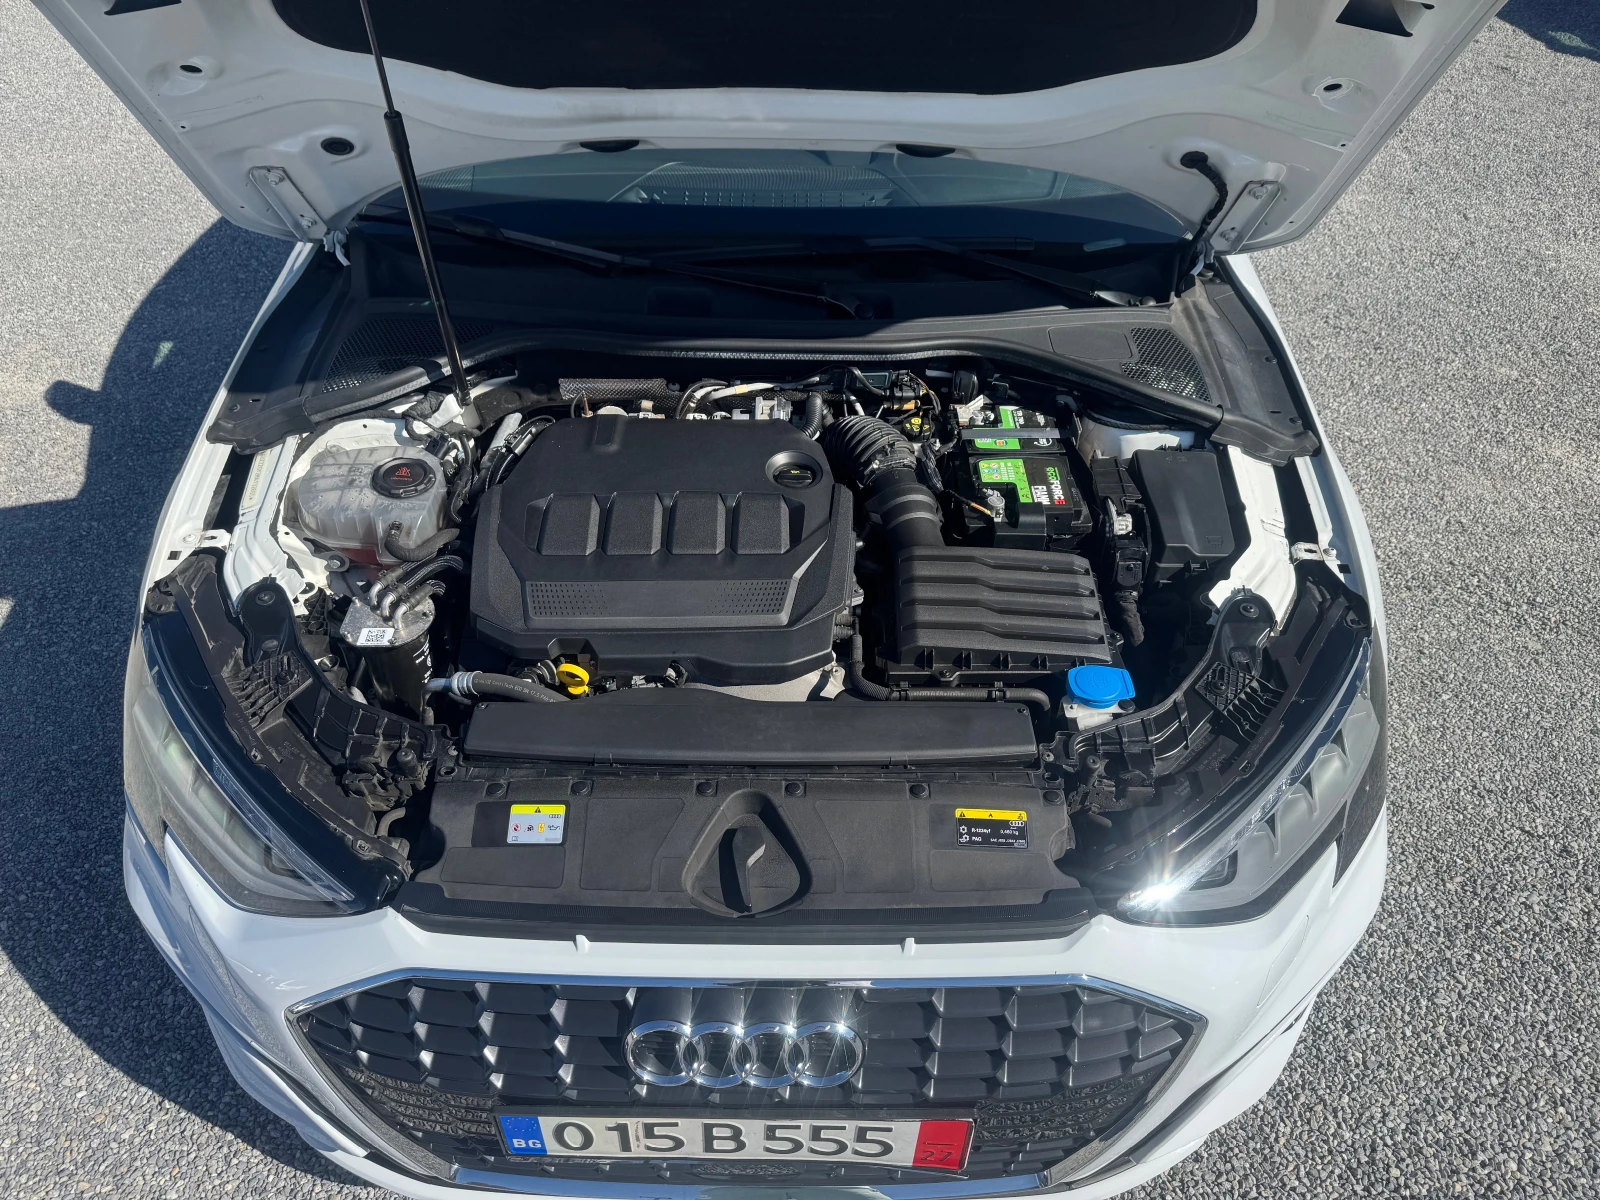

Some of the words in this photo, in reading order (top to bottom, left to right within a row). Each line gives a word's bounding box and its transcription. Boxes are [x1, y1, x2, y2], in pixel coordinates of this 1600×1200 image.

[1045, 466, 1066, 505] ecoFORCE
[512, 1138, 541, 1148] BG
[552, 1120, 686, 1153] 015
[702, 1121, 748, 1153] B
[763, 1123, 895, 1157] 555
[920, 1150, 953, 1161] 27
